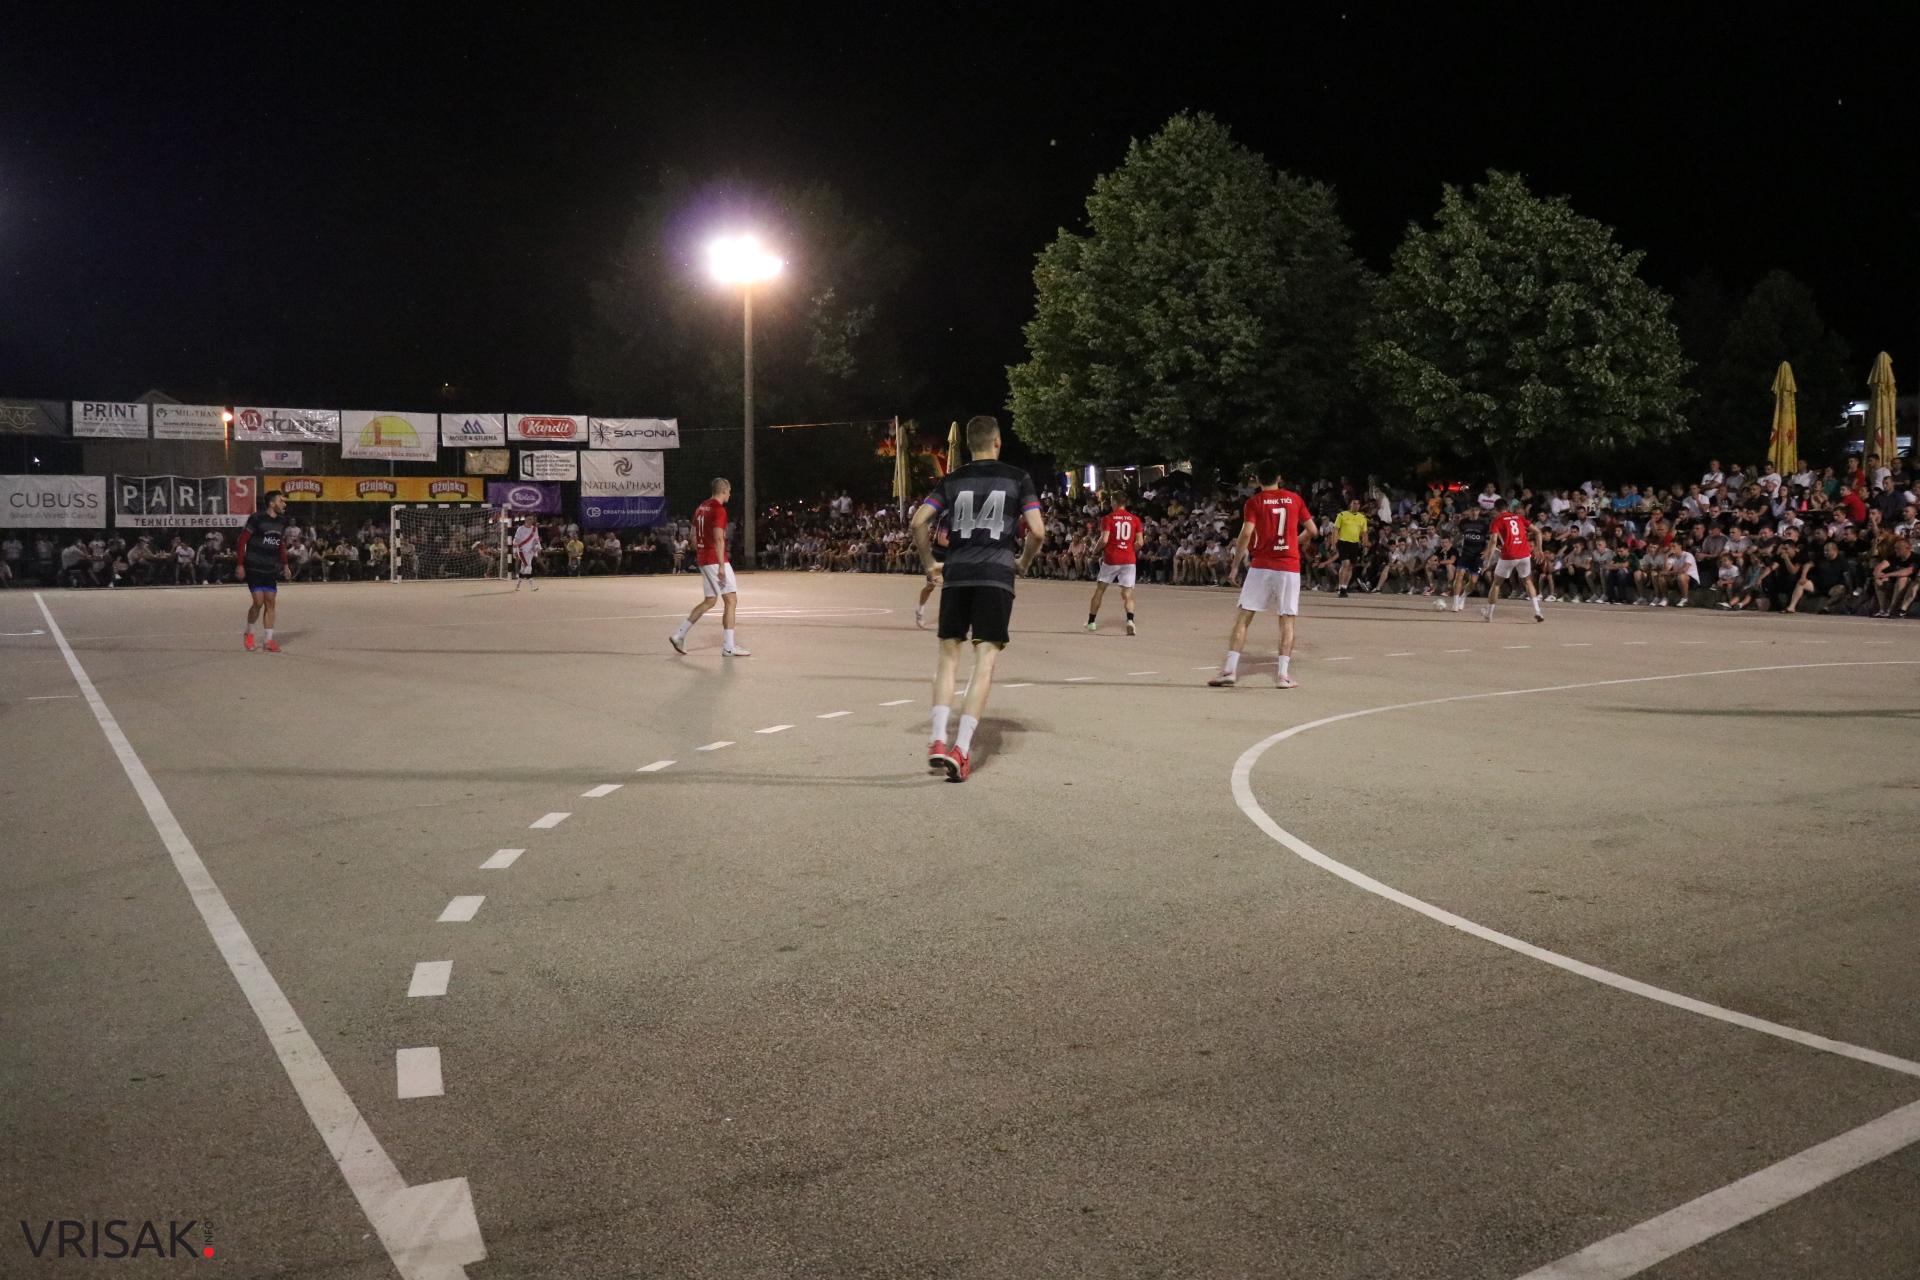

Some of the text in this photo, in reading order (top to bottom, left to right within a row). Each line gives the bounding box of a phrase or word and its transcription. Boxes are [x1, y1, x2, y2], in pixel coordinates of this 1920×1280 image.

[83, 403, 138, 419] PRINT
[526, 419, 570, 434] Kandit
[614, 429, 677, 438] SAPONIA
[359, 480, 395, 493] Ožujsko
[9, 492, 98, 508] CUBUSS
[122, 476, 249, 515] PARTS
[134, 515, 238, 527] TEHNIČKI PREGLED
[951, 490, 1009, 540] 44
[1272, 507, 1287, 536] 7
[696, 515, 706, 538] 11
[1114, 521, 1132, 541] 10
[1510, 519, 1520, 535] 8
